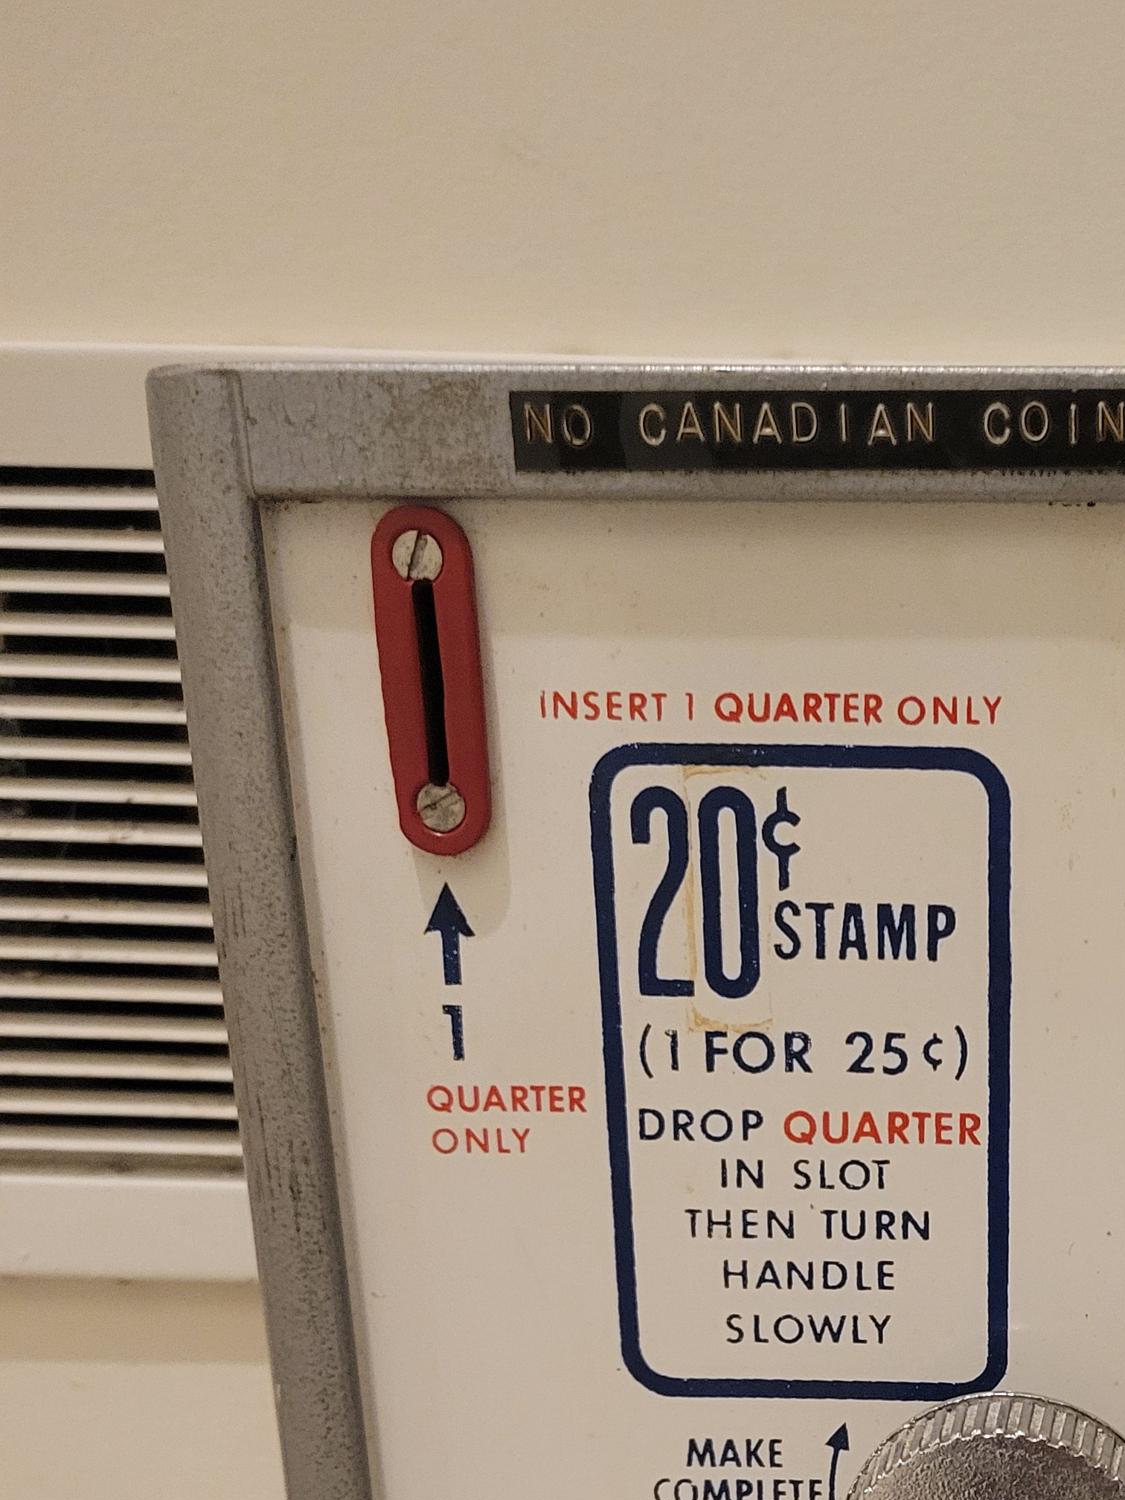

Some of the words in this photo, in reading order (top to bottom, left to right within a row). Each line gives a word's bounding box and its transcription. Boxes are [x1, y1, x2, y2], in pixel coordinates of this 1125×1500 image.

[522, 402, 593, 448] NO
[640, 400, 936, 448] CANADIAN
[540, 691, 667, 722] INSERT
[686, 693, 693, 720] 1
[715, 693, 882, 726] QUARTER
[898, 696, 1001, 725] ONLY
[774, 900, 956, 962] STAMP
[442, 1005, 465, 1061] 1
[639, 1023, 679, 1079] (1
[705, 1030, 813, 1074] FOR
[427, 1085, 586, 1113] QUARTER
[432, 1128, 529, 1154] ONLY
[639, 1108, 763, 1142] DROP
[784, 1111, 981, 1145] QUARTER
[721, 1159, 763, 1189] IN
[794, 1159, 890, 1190] SLOT
[685, 1209, 794, 1239] THEN
[820, 1210, 929, 1240] TURN
[723, 1259, 894, 1291] HANDLE
[726, 1314, 891, 1344] SLOWLY
[686, 1438, 783, 1468] MAKE
